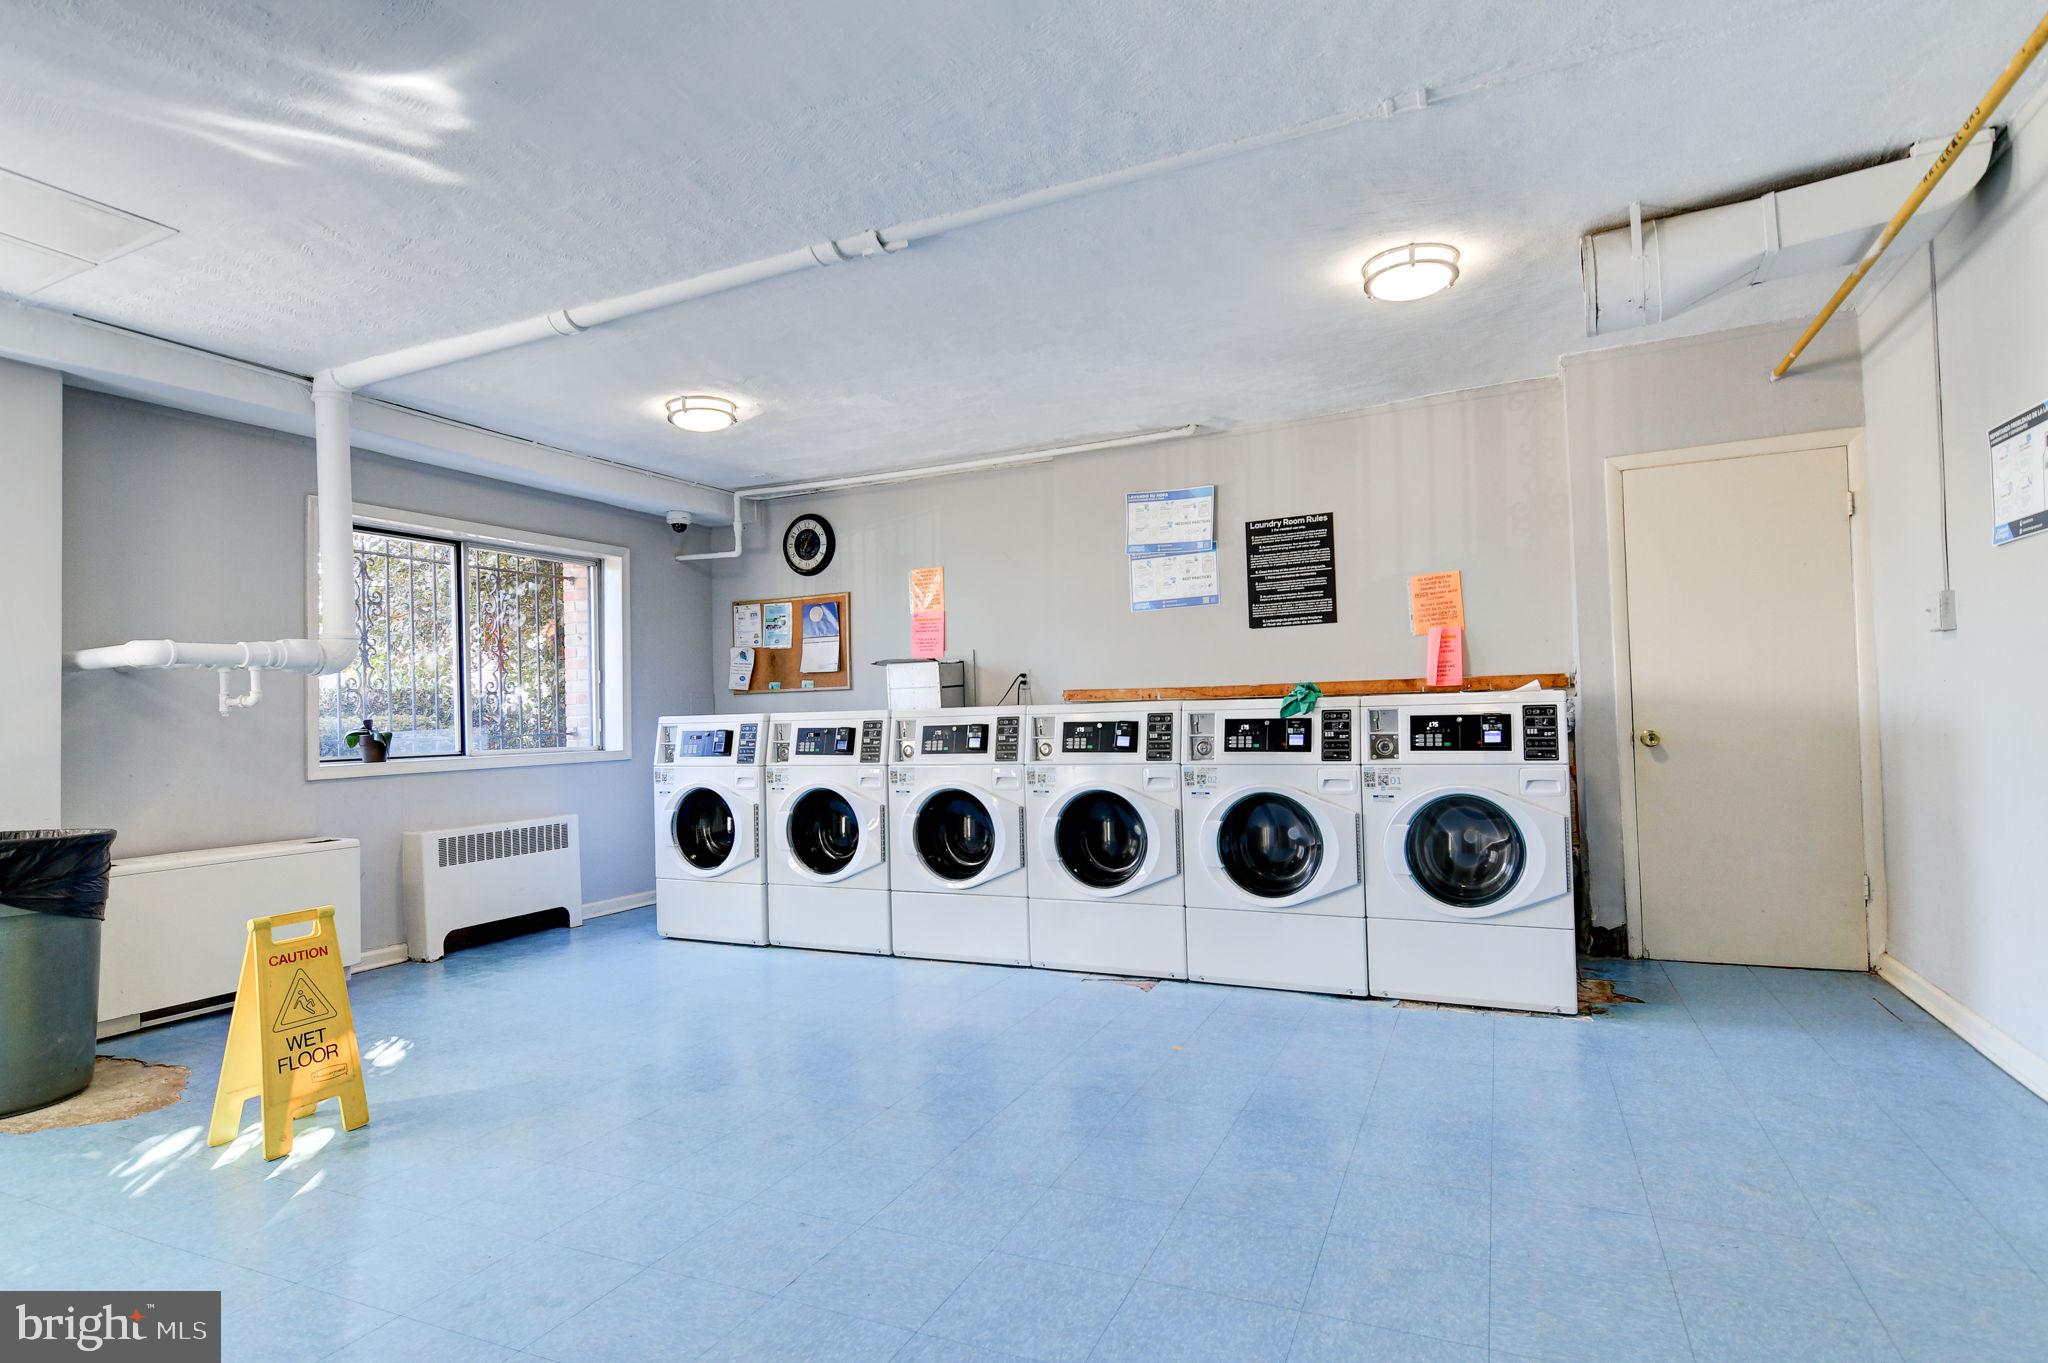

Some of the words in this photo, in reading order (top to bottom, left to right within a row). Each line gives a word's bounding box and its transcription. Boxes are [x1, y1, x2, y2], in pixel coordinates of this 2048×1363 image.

[1250, 520, 1282, 529] Laundry
[1306, 515, 1328, 523] Rules
[269, 946, 329, 967] CAUTION
[286, 1027, 327, 1052] WET
[278, 1043, 339, 1075] FLOOR
